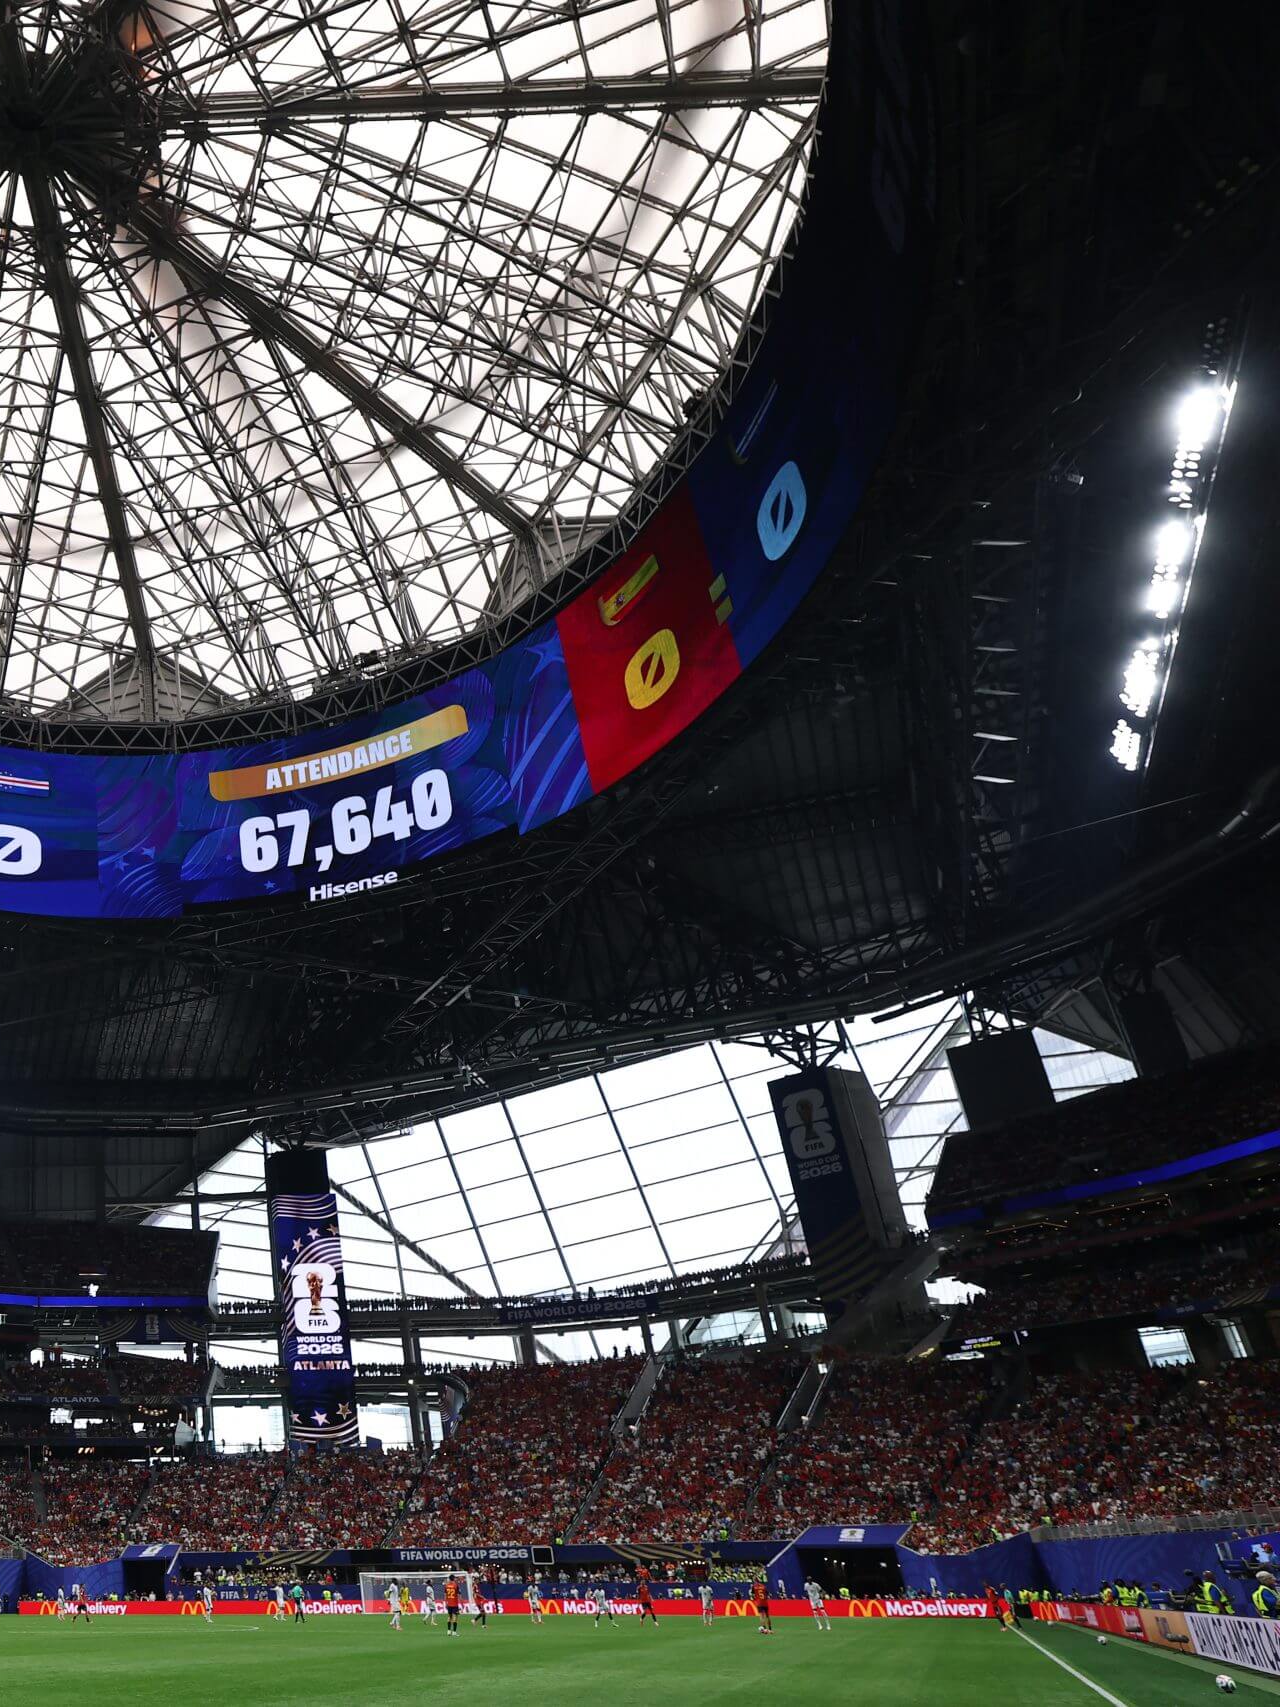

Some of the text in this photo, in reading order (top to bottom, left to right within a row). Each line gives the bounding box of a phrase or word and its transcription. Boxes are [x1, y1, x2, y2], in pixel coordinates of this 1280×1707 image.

[756, 460, 808, 561] 0
[624, 628, 681, 710] 0
[266, 730, 413, 790] ATTENDANCE
[239, 768, 453, 873] 67,640
[310, 871, 399, 902] Hisense
[804, 1141, 825, 1153] FIFA
[798, 1161, 844, 1181] 2026
[507, 1298, 648, 1321] FIFA WORLD CUP 2026
[308, 1319, 329, 1327] FIFA
[296, 1335, 343, 1344] WORLD CUP
[297, 1344, 344, 1355] 2026
[293, 1359, 351, 1371] ATLANTA
[401, 1548, 529, 1561] FIFA WORLD CUP 2026
[220, 1591, 240, 1600] FIFA
[667, 1588, 694, 1598] FA
[885, 1599, 987, 1618] McDelivery
